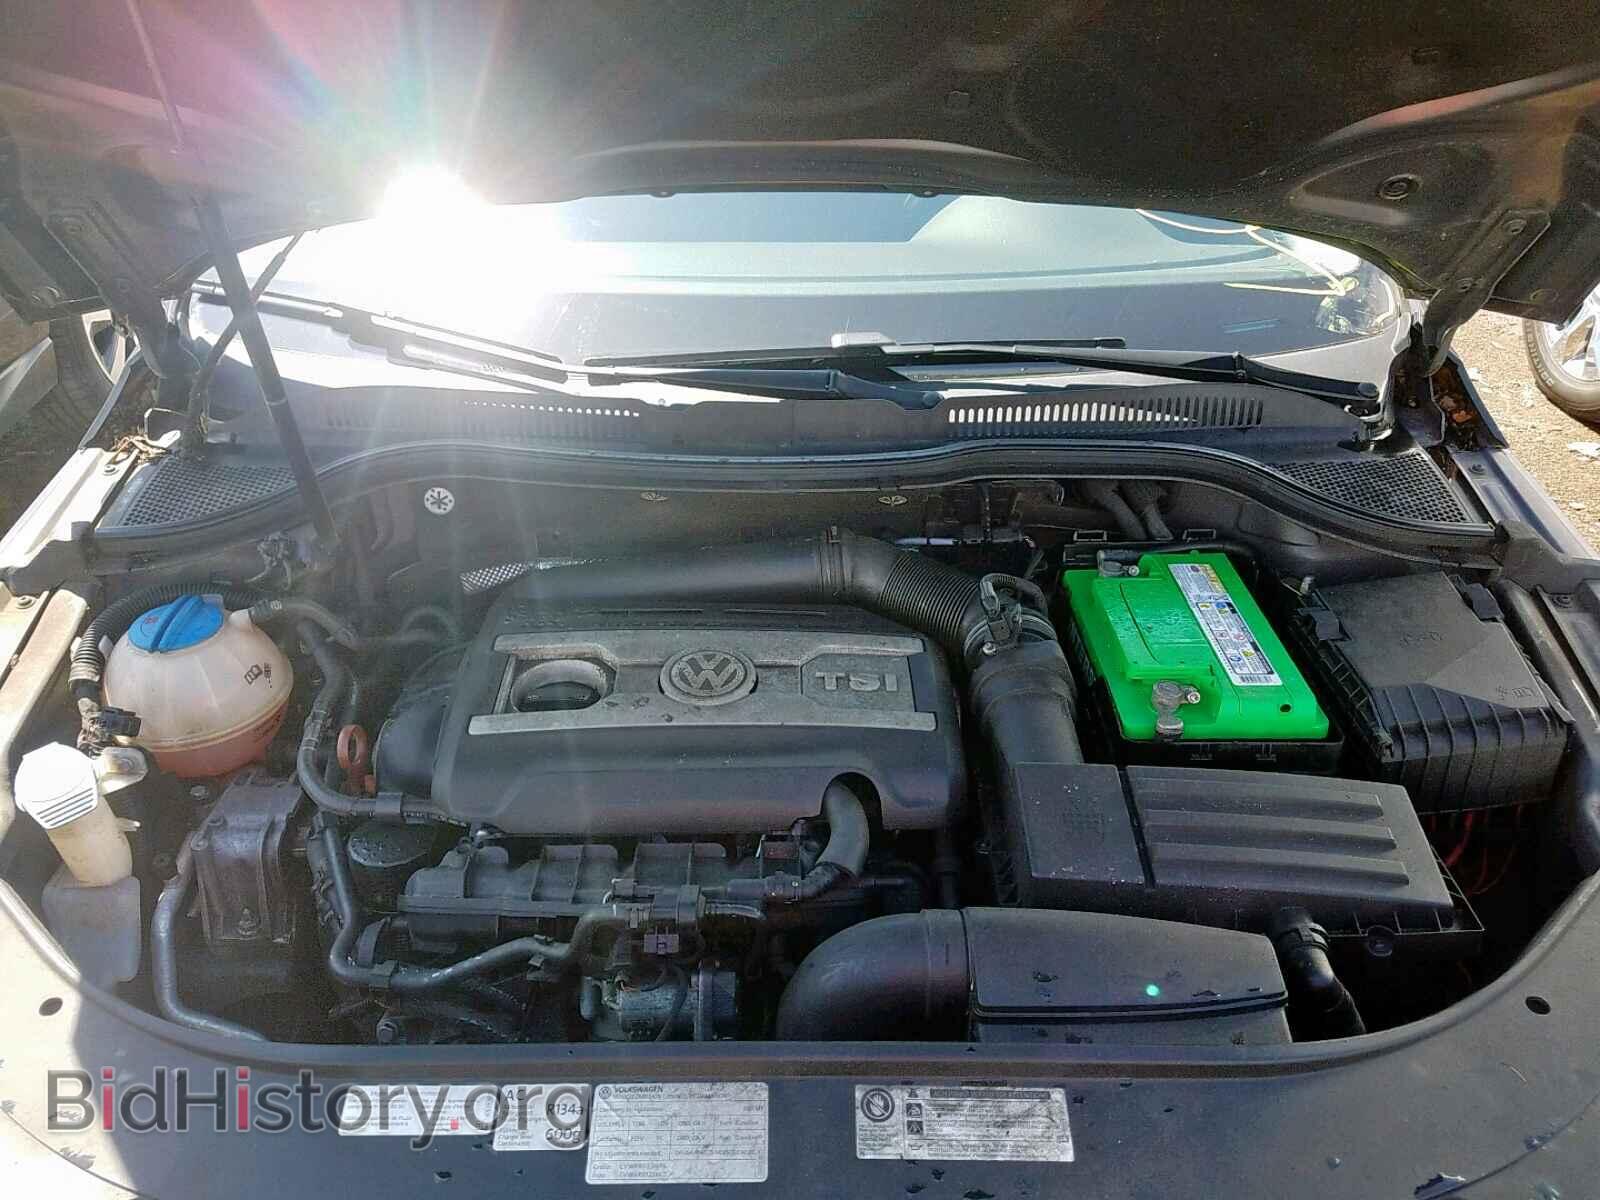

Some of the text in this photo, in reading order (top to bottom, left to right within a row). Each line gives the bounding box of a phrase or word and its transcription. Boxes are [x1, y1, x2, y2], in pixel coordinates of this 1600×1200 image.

[815, 671, 898, 692] TSI
[547, 1103, 584, 1116] R134a
[545, 1128, 581, 1143] 600g
